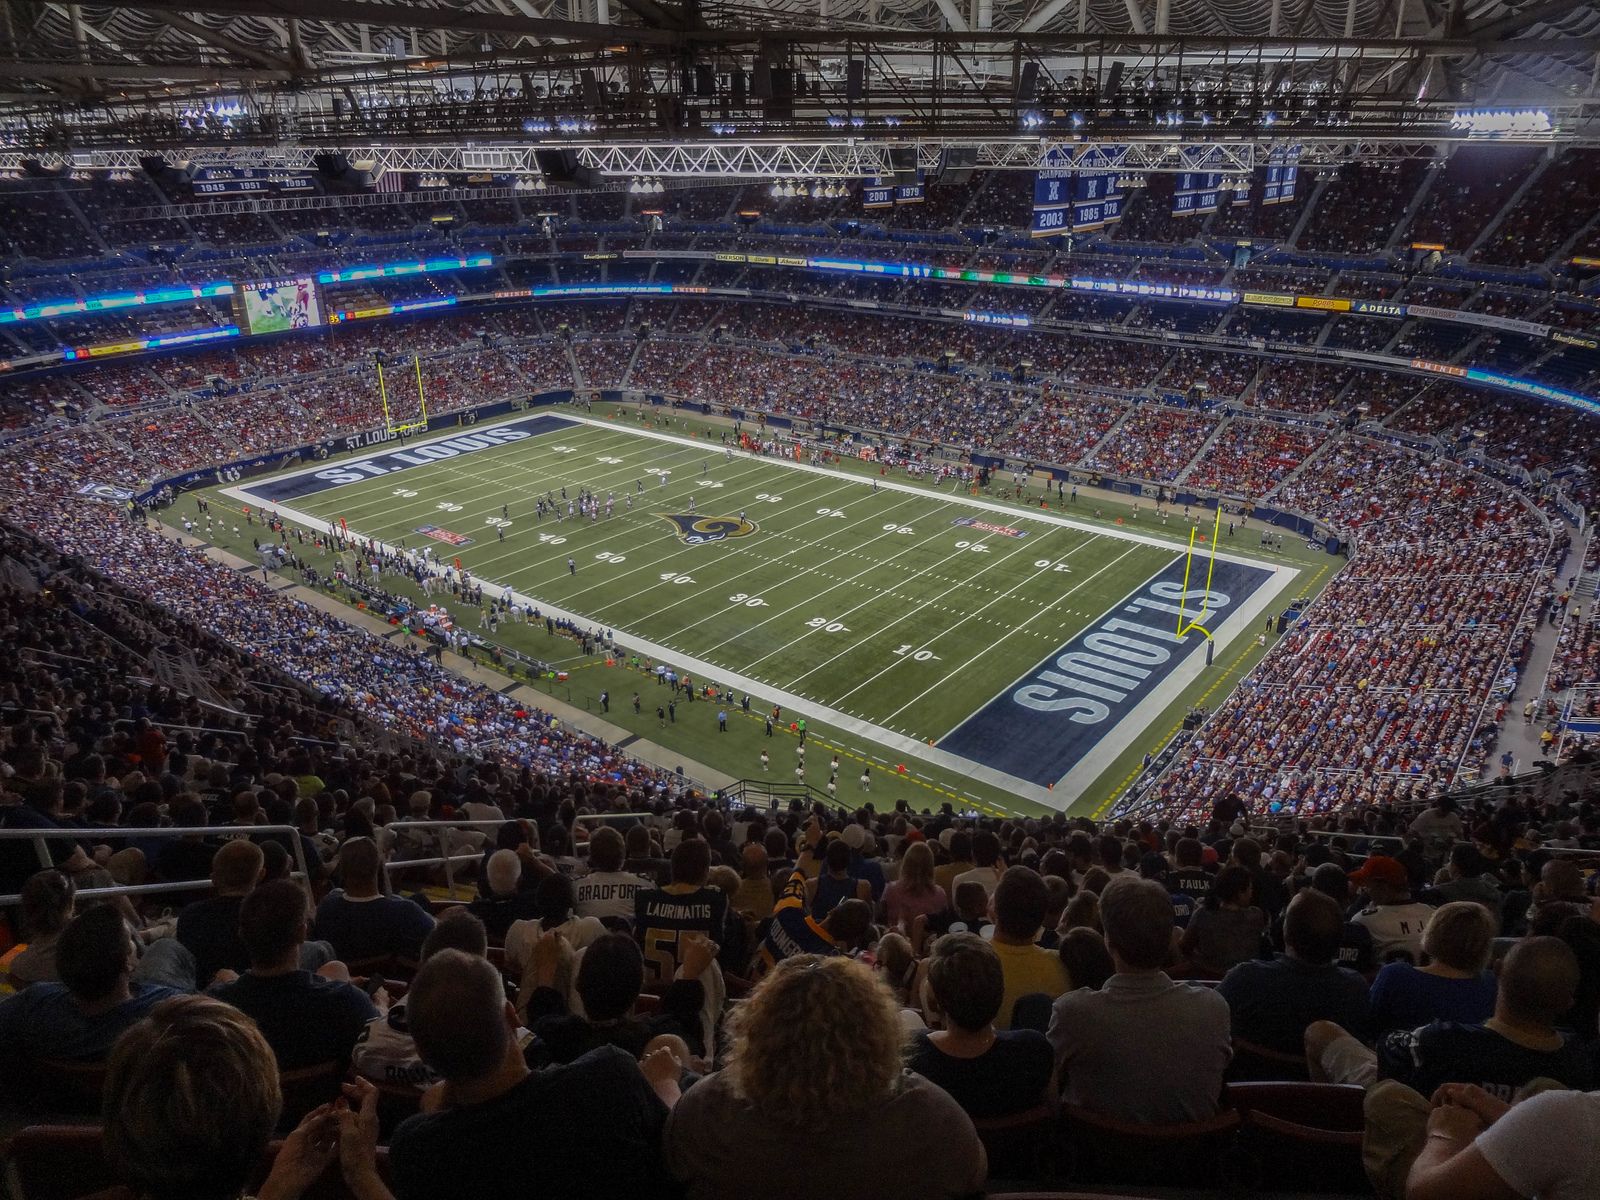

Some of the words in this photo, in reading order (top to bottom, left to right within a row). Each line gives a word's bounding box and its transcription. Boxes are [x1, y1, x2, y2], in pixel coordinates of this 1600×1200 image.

[200, 184, 226, 192] 1945
[240, 182, 261, 190] 1951
[902, 188, 920, 197] 1979
[869, 192, 888, 201] 2001
[1080, 208, 1099, 221] 1985
[1104, 202, 1118, 215] 978
[1040, 212, 1063, 227] 2003
[1369, 304, 1401, 315] DELTA
[346, 434, 363, 449] ST.
[365, 427, 398, 444] LOUIS
[315, 461, 402, 484] ST.
[390, 428, 532, 465] LOUIS
[595, 551, 627, 564] 50
[659, 571, 691, 585] 40
[729, 593, 763, 608] 30
[805, 617, 845, 633] 20
[893, 644, 934, 661] 10
[1013, 618, 1189, 725] LOUIS
[1179, 879, 1210, 889] FAULK
[646, 902, 711, 920] LAURINAITIS
